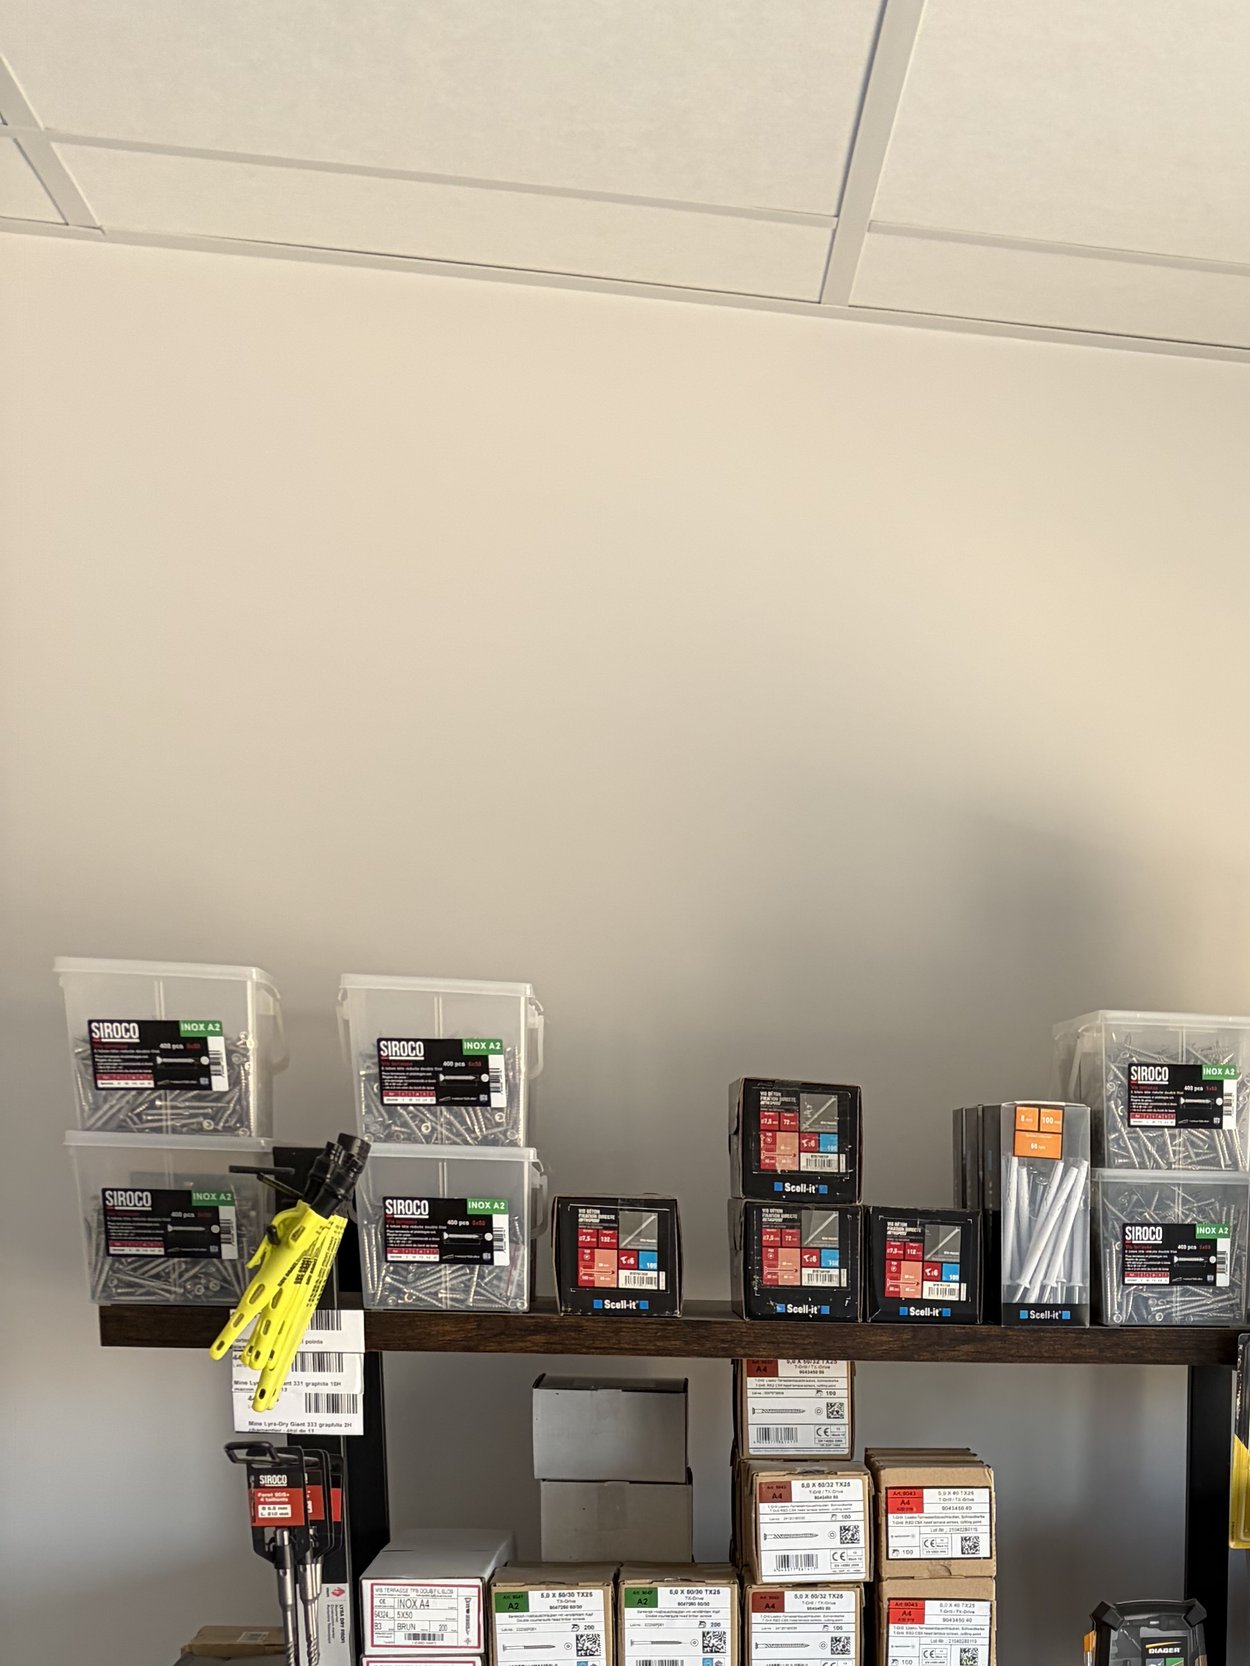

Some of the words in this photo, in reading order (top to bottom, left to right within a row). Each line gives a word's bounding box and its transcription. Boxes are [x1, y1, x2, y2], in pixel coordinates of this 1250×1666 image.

[91, 1022, 139, 1038] SIROCO
[380, 1041, 424, 1057] SIROCO
[464, 1042, 487, 1050] INOX
[489, 1042, 500, 1050] A2
[1131, 1067, 1169, 1081] SIROCO
[785, 1183, 816, 1193] Scell-it
[105, 1190, 151, 1209] SIROCO
[385, 1200, 429, 1215] SIROCO
[469, 1201, 491, 1210] INOX
[494, 1202, 505, 1210] A2
[1125, 1226, 1162, 1241] SIROCO
[604, 1300, 637, 1309] Scell-it
[259, 1475, 287, 1484] SIROCO
[398, 1599, 418, 1608] INOX
[420, 1599, 430, 1608] A4
[508, 1602, 519, 1610] A2
[637, 1598, 648, 1606] A2
